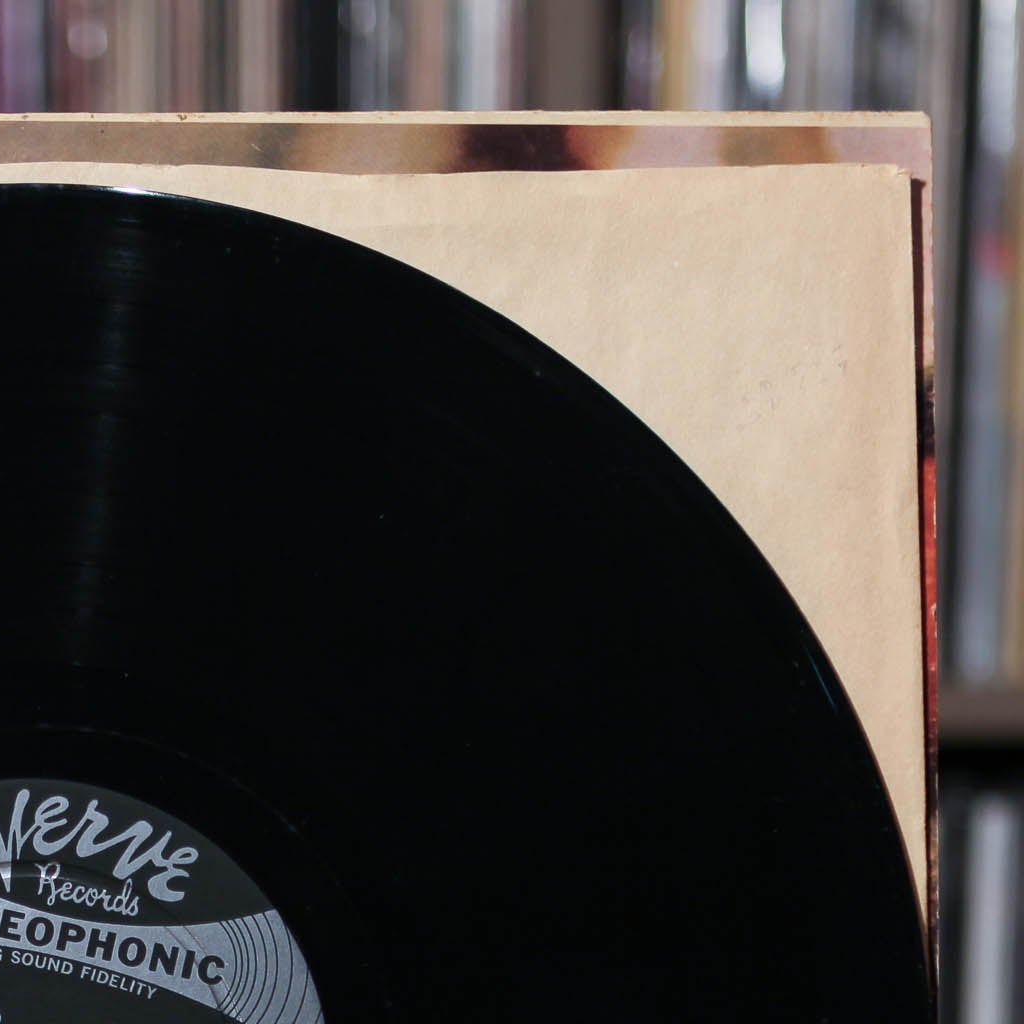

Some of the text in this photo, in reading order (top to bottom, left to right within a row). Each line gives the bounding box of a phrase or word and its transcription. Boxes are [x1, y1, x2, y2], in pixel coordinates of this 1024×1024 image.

[35, 861, 139, 917] Records
[10, 951, 73, 975] SOUND
[80, 966, 158, 1000] FIDELITY
